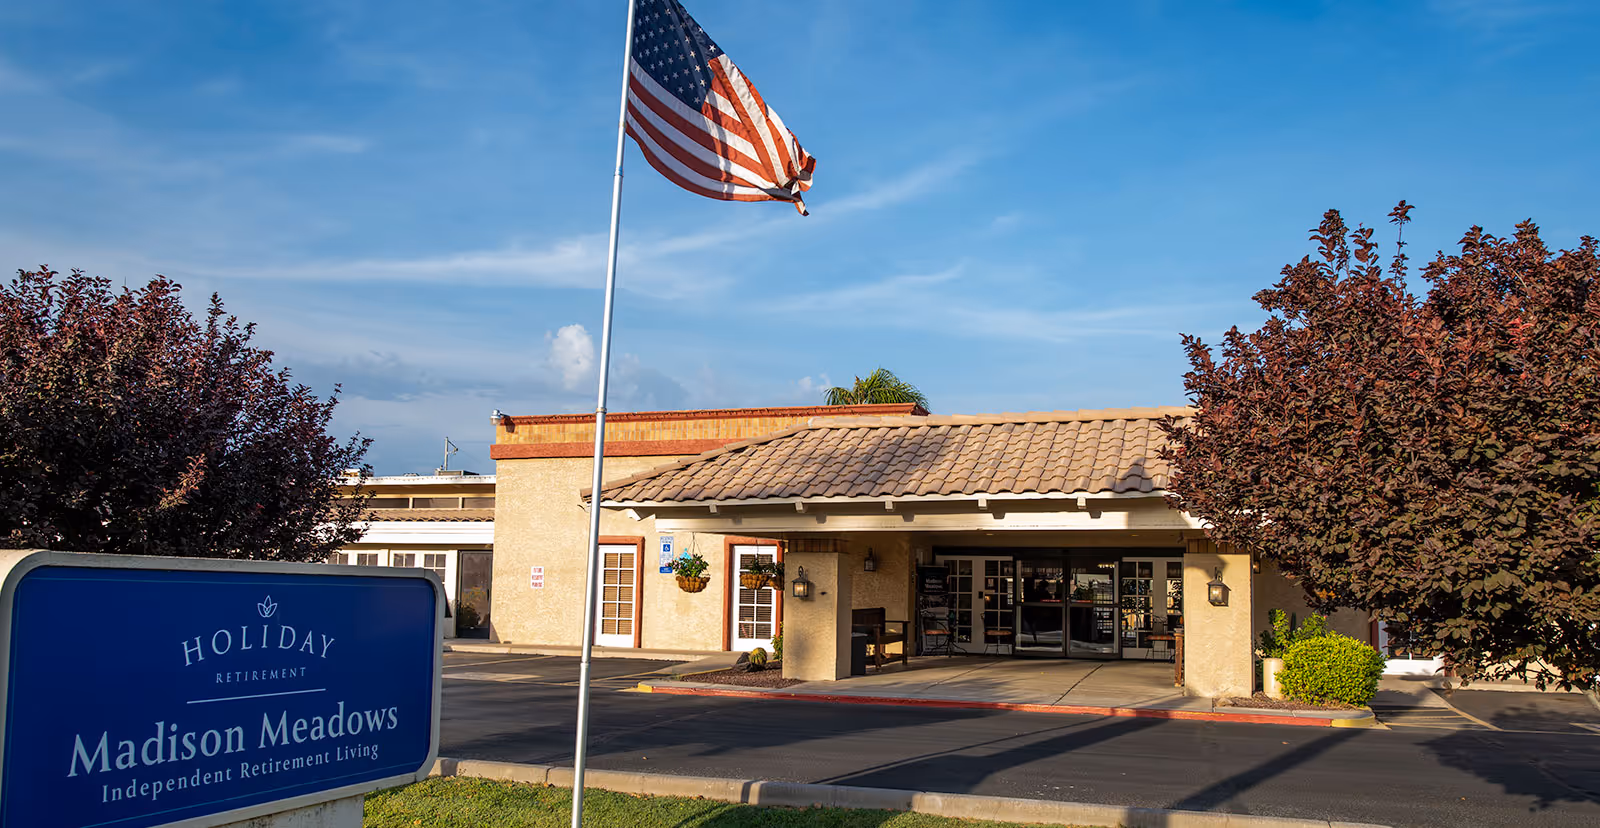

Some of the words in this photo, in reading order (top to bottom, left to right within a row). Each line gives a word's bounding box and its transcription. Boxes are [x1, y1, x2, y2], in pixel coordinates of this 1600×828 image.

[181, 624, 335, 667] HOLIDAY
[215, 667, 307, 684] RETIREMENT
[67, 721, 245, 778] Madison
[258, 701, 399, 749] Meadows
[101, 767, 233, 803] Independent
[240, 752, 330, 779] Retirement
[336, 742, 379, 762] Living
